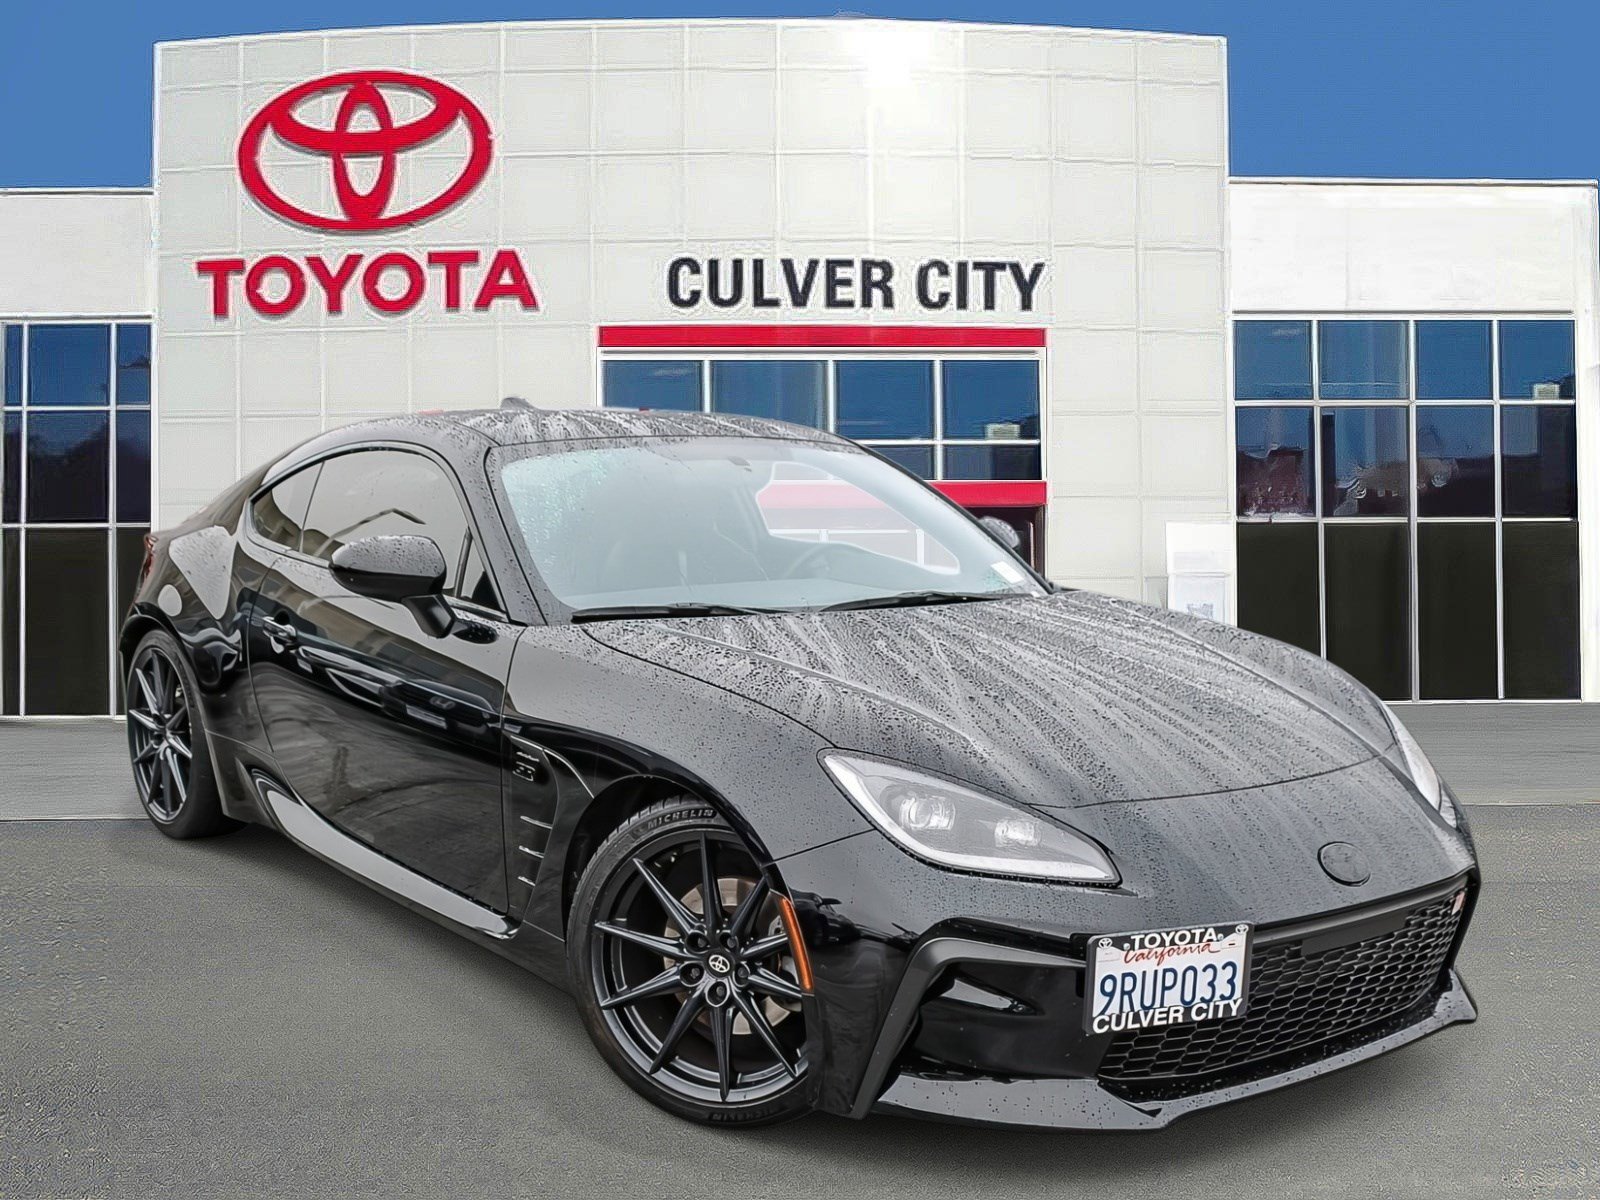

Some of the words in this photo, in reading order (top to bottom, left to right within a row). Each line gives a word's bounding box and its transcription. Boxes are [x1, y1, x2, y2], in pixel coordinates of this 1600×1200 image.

[195, 249, 540, 319] TOYOTA
[667, 257, 895, 309] CULVER
[915, 258, 1046, 311] CITY
[647, 809, 714, 830] MICHELIN
[1130, 928, 1218, 951] TOYOTA
[1099, 961, 1238, 1016] 9RUP033
[1092, 1005, 1184, 1034] CULVER
[1190, 998, 1243, 1021] CITY
